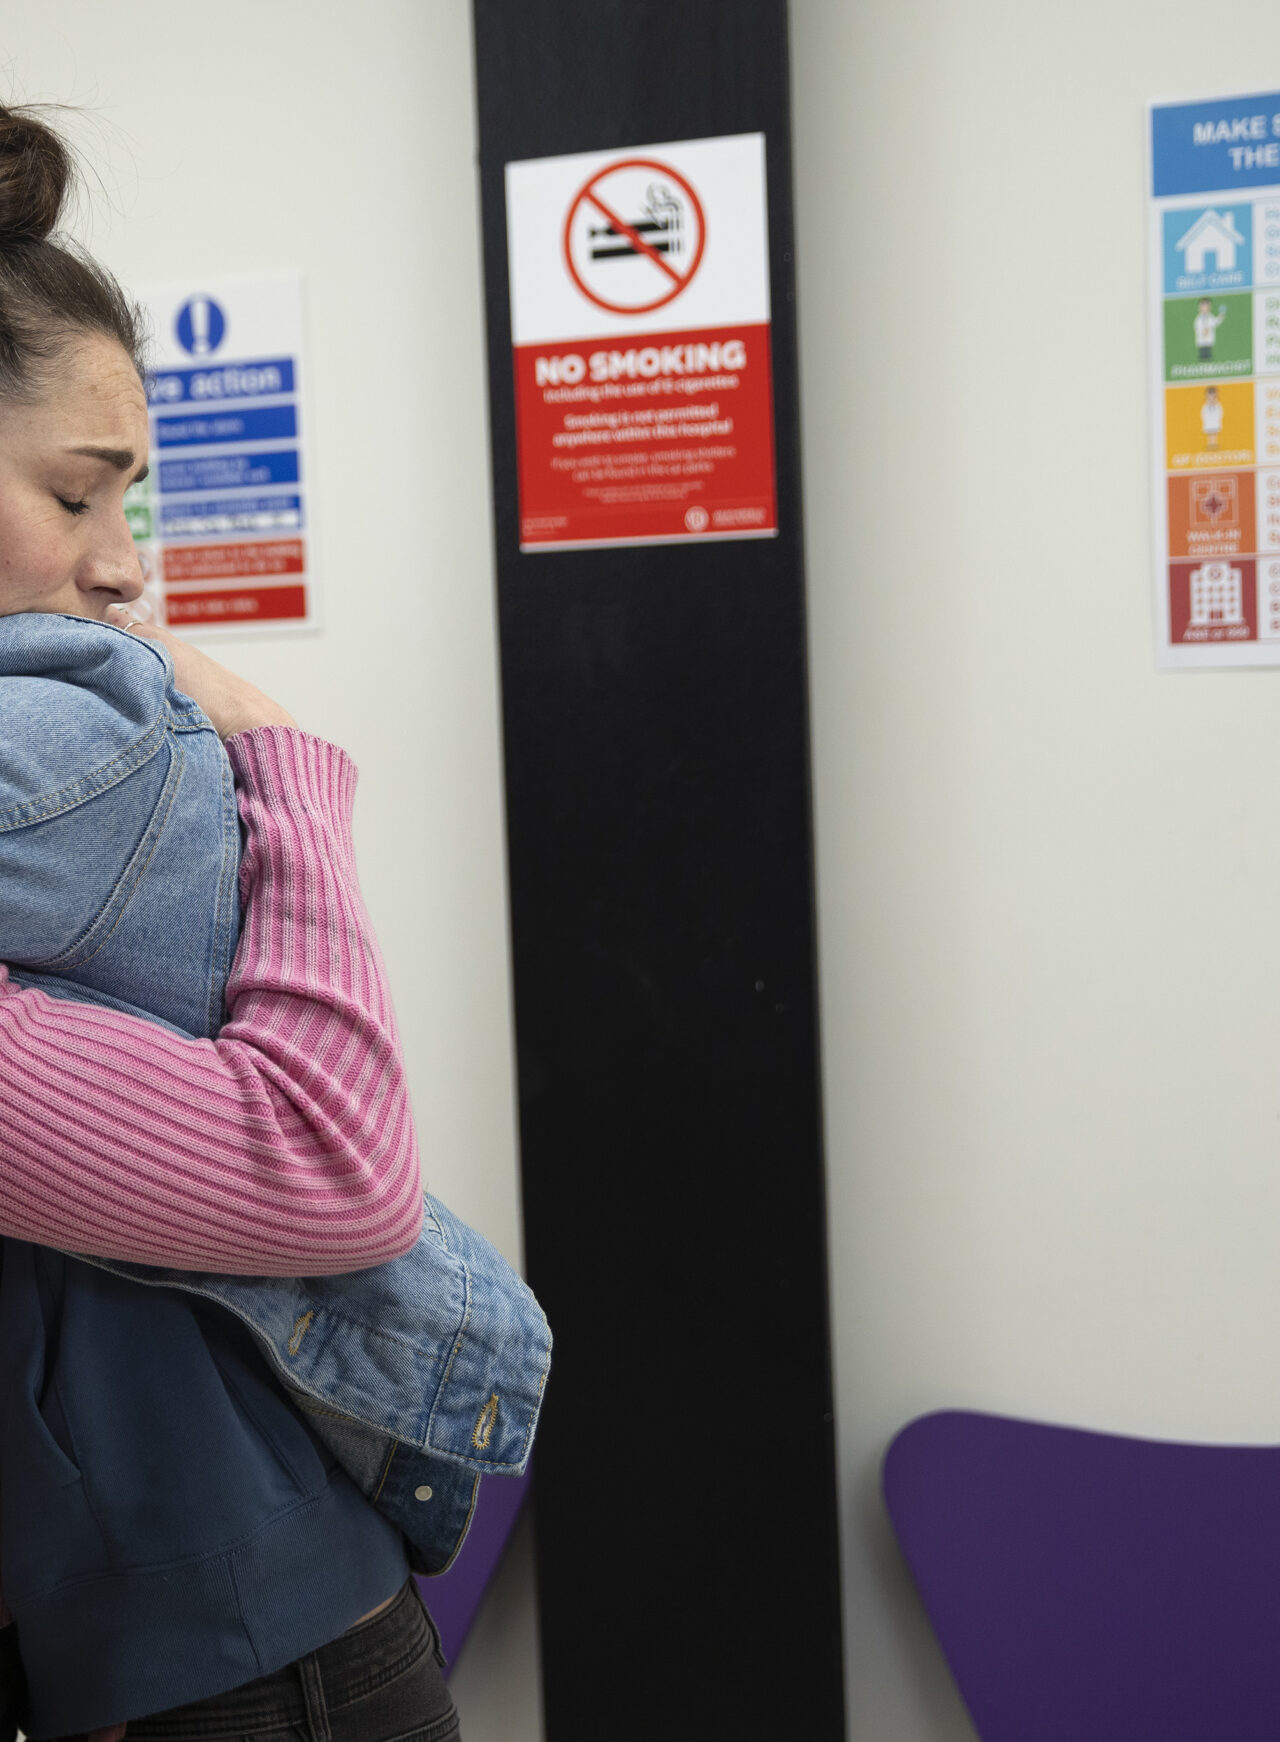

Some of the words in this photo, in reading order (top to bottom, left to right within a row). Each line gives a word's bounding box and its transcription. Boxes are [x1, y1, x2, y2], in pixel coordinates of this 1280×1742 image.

[1193, 115, 1267, 146] MAKE
[1227, 142, 1280, 171] THE
[535, 354, 586, 387] NO
[589, 339, 747, 382] SMOKING
[190, 366, 281, 400] action
[543, 383, 601, 403] including
[563, 412, 618, 430] Smoking
[654, 401, 719, 423] permitted
[552, 429, 611, 448] anywhere
[678, 417, 733, 438] hospital
